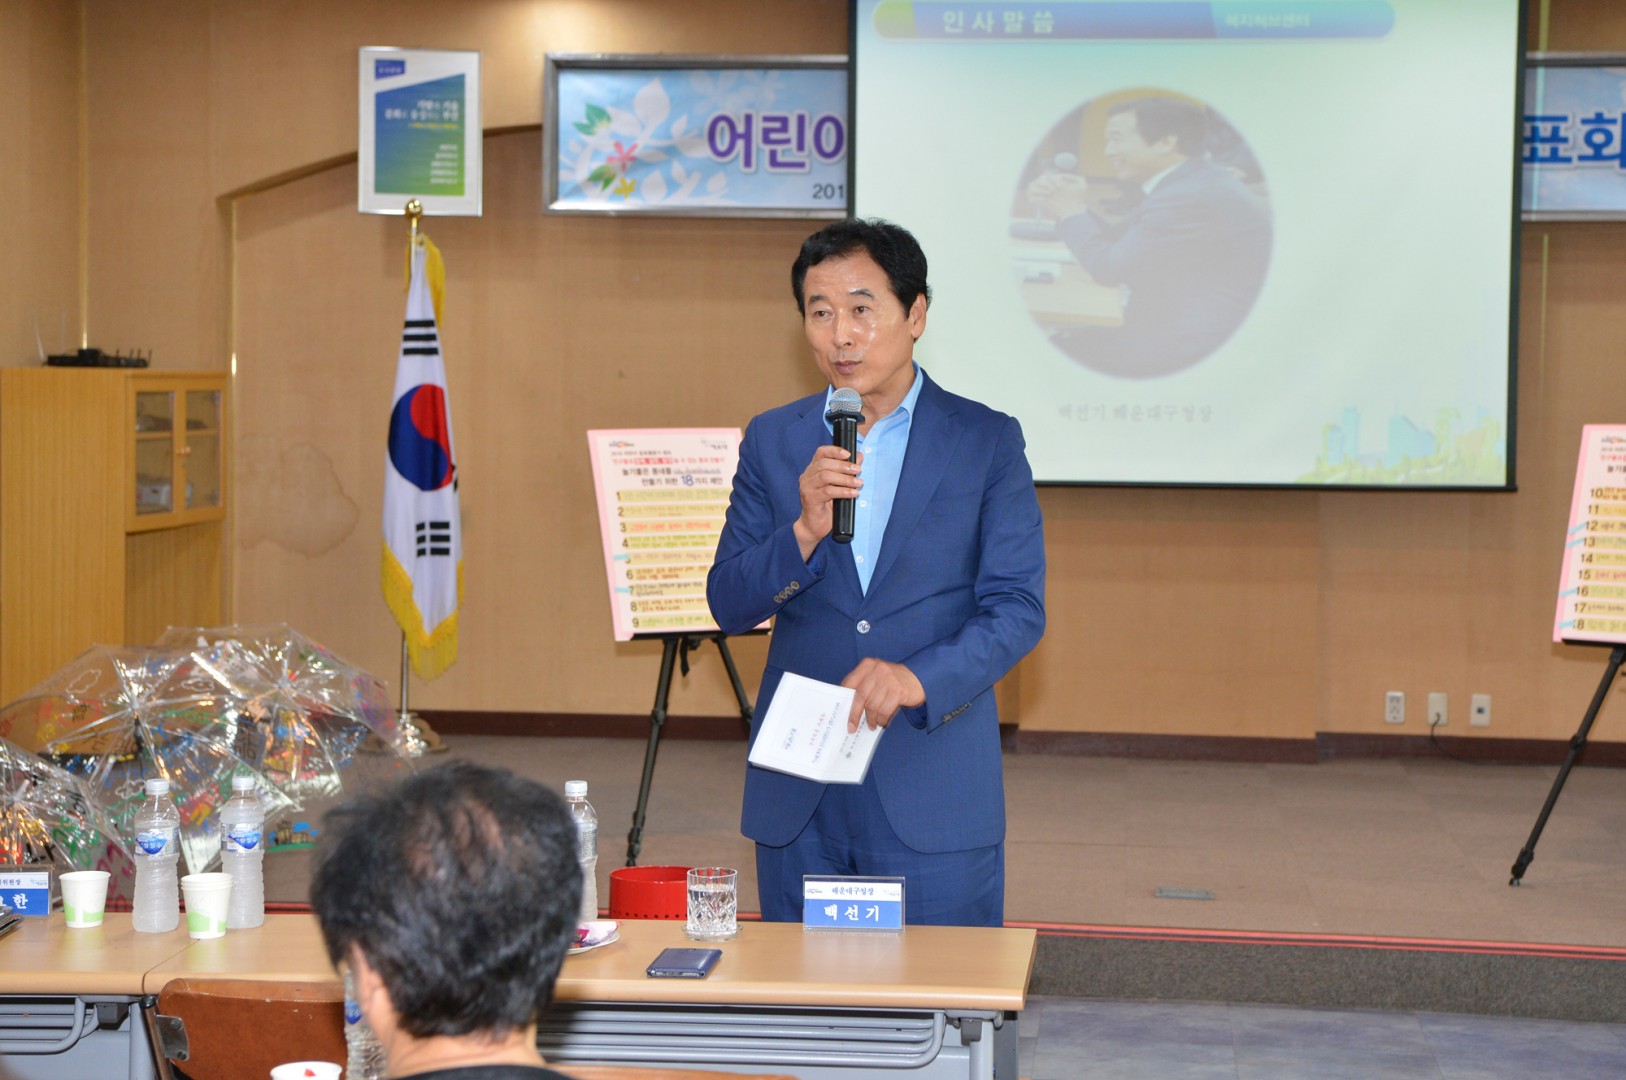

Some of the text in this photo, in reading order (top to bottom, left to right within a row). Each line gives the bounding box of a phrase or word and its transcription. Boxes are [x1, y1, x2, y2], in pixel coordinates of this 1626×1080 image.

[1590, 488, 1603, 499] 10
[617, 507, 625, 516] 2
[1588, 504, 1599, 514] 11
[620, 522, 627, 533] 3
[1585, 521, 1598, 531] 12
[622, 538, 629, 548] 4
[1581, 553, 1593, 564] 14
[626, 569, 634, 580] 6
[1578, 569, 1591, 580] 15
[1576, 586, 1589, 597] 16
[630, 602, 638, 612] 8
[1574, 602, 1587, 613] 17
[632, 618, 640, 628] 9
[823, 903, 880, 922] 백선기
